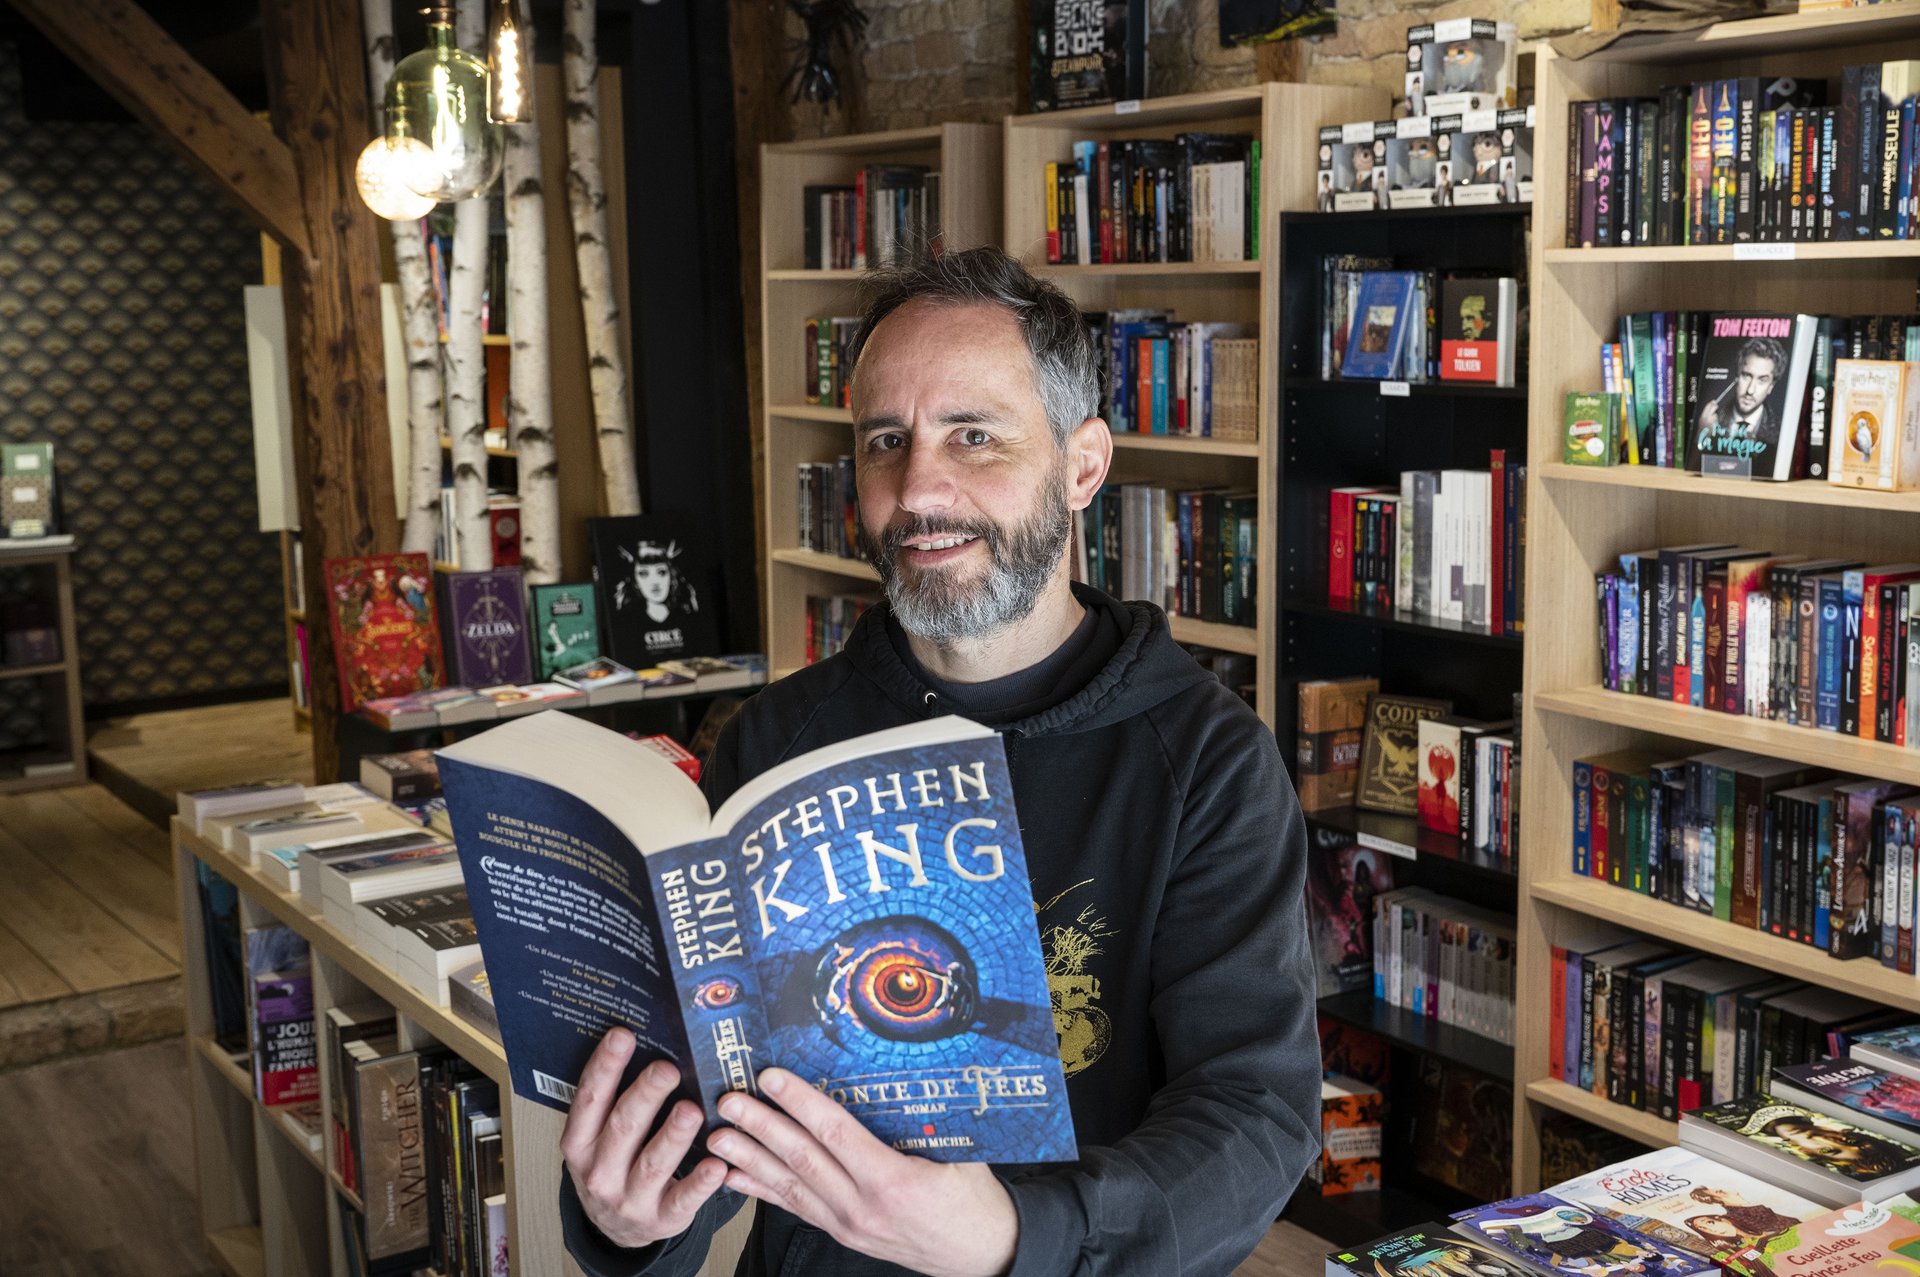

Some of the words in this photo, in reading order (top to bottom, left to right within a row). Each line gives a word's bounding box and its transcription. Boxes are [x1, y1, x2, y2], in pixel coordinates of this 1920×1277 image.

[1740, 99, 1753, 162] PRISME
[1793, 118, 1804, 152] GAMES
[1822, 117, 1833, 151] GAMES
[1884, 109, 1900, 160] SEULE
[1597, 114, 1613, 214] VAMPS
[1792, 155, 1803, 192] HUNGER
[1821, 154, 1832, 192] HUNGER
[1714, 319, 1740, 337] TOM
[1741, 318, 1791, 337] FELTON
[1454, 360, 1481, 372] TOLKIEN
[1717, 437, 1767, 461] magie
[467, 621, 515, 639] ZELDA
[644, 628, 683, 644] CIRCE
[741, 761, 991, 876] STEPHEN
[751, 817, 1005, 940] KING
[661, 868, 704, 970] STEPHEN
[690, 859, 743, 961] KING
[922, 1077, 960, 1099] DE
[903, 1103, 946, 1115] ROMAN
[397, 1075, 426, 1211] WITCHER
[892, 1138, 927, 1149] ALBIN
[929, 1136, 974, 1148] MICHEL
[1596, 1169, 1665, 1194] Enola
[1610, 1174, 1691, 1206] HOLMES
[1787, 1237, 1861, 1267] Cueillette
[1834, 1255, 1844, 1263] le
[1849, 1249, 1882, 1267] Feu
